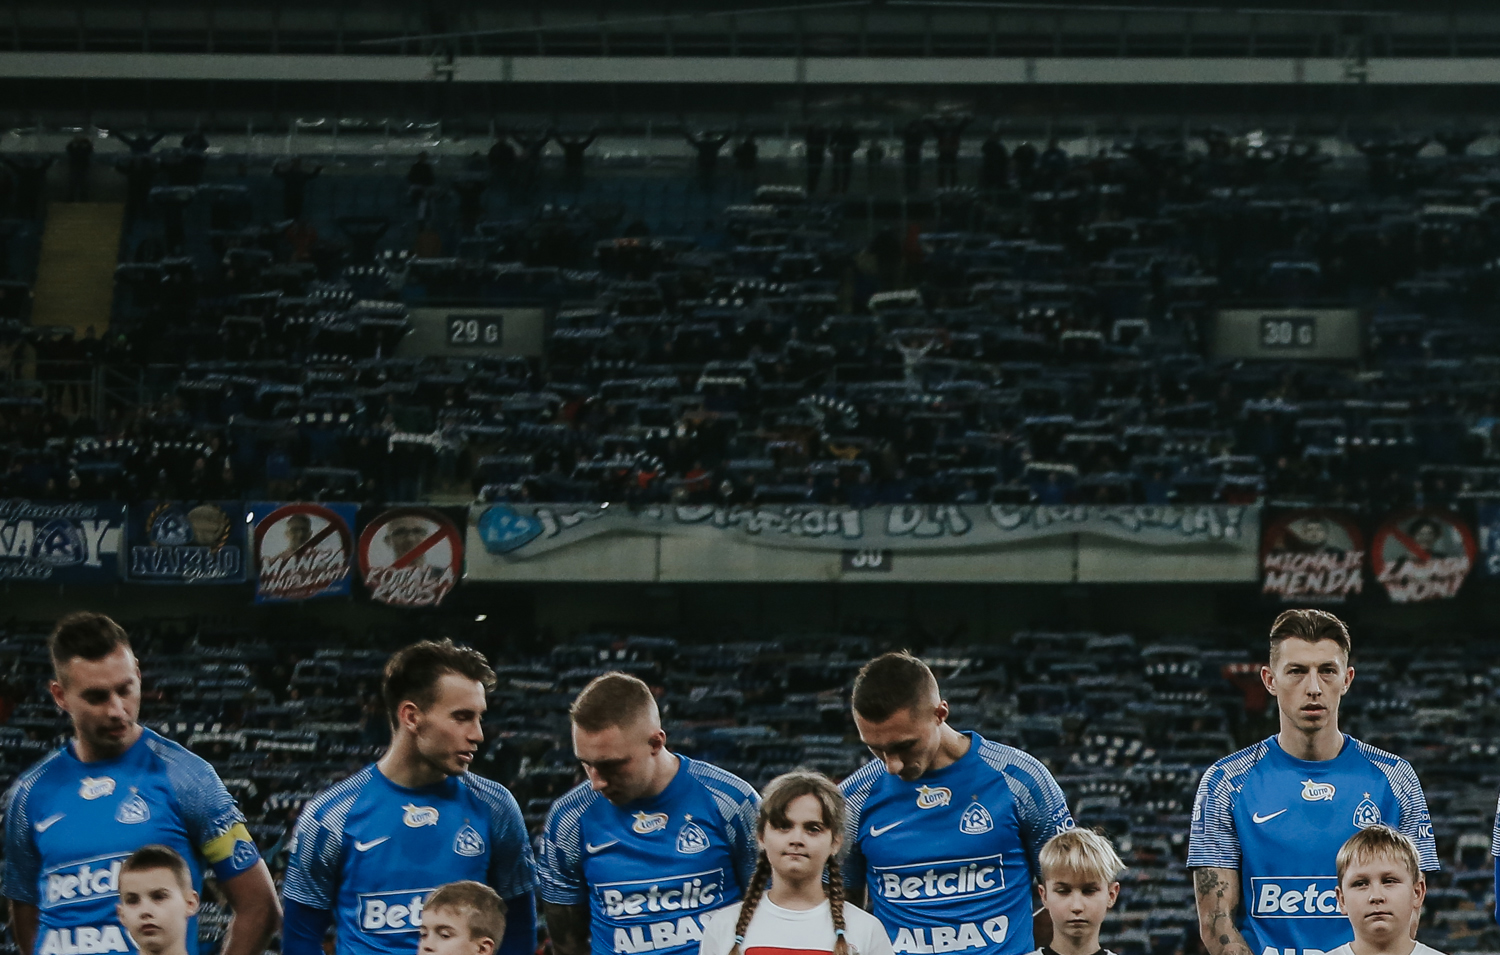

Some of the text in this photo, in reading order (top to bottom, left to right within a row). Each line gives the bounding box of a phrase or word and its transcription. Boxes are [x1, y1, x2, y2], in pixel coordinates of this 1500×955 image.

[451, 319, 479, 343] 29
[1262, 570, 1364, 596] MENDA
[46, 860, 121, 900] Betcl
[882, 863, 996, 900] Betclic
[602, 879, 718, 918] Betclic
[1257, 884, 1341, 914] Betc
[614, 914, 703, 954] ALBA
[893, 922, 988, 955] ALBA
